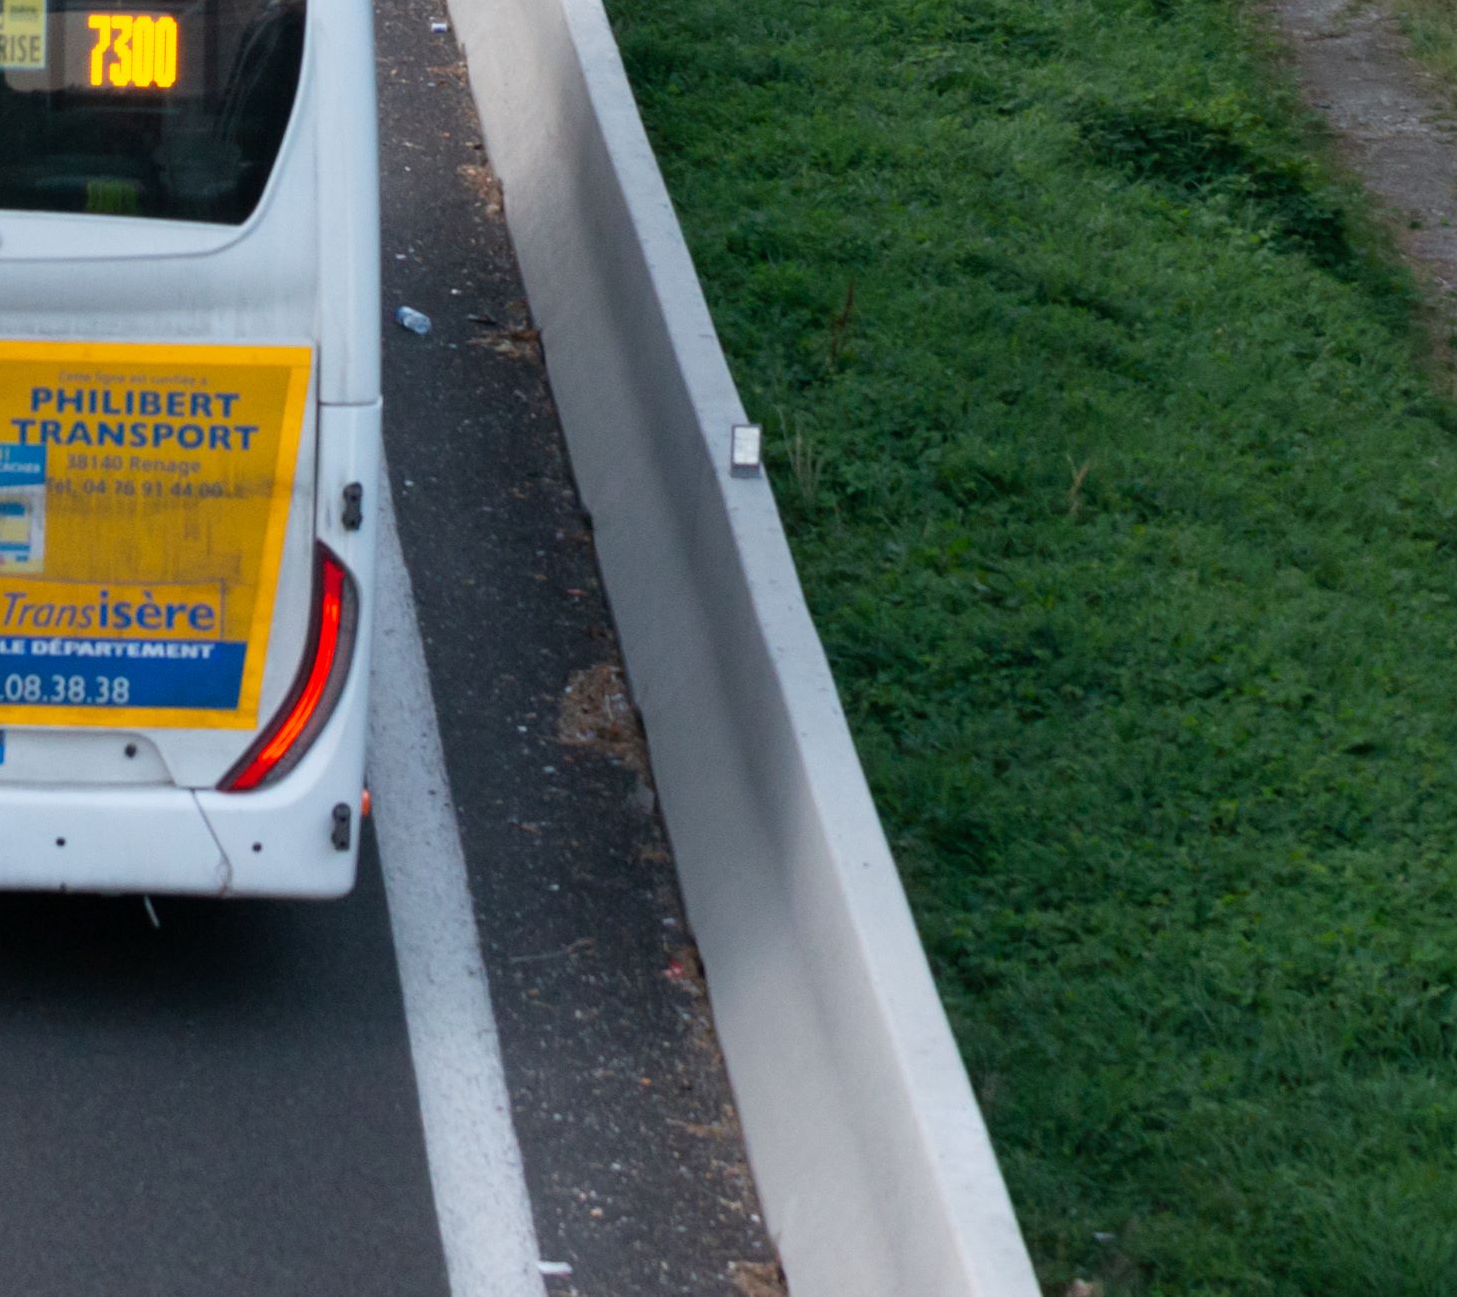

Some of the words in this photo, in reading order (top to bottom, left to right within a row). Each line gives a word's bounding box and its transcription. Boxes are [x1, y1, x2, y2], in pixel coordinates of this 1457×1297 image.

[88, 14, 178, 88] 7300
[31, 386, 240, 419] PHILIBERT
[11, 419, 259, 451] TRANSPORT
[130, 456, 201, 475] Renage
[2, 590, 216, 632] Transisère
[31, 637, 215, 659] DÉPARTEMENT
